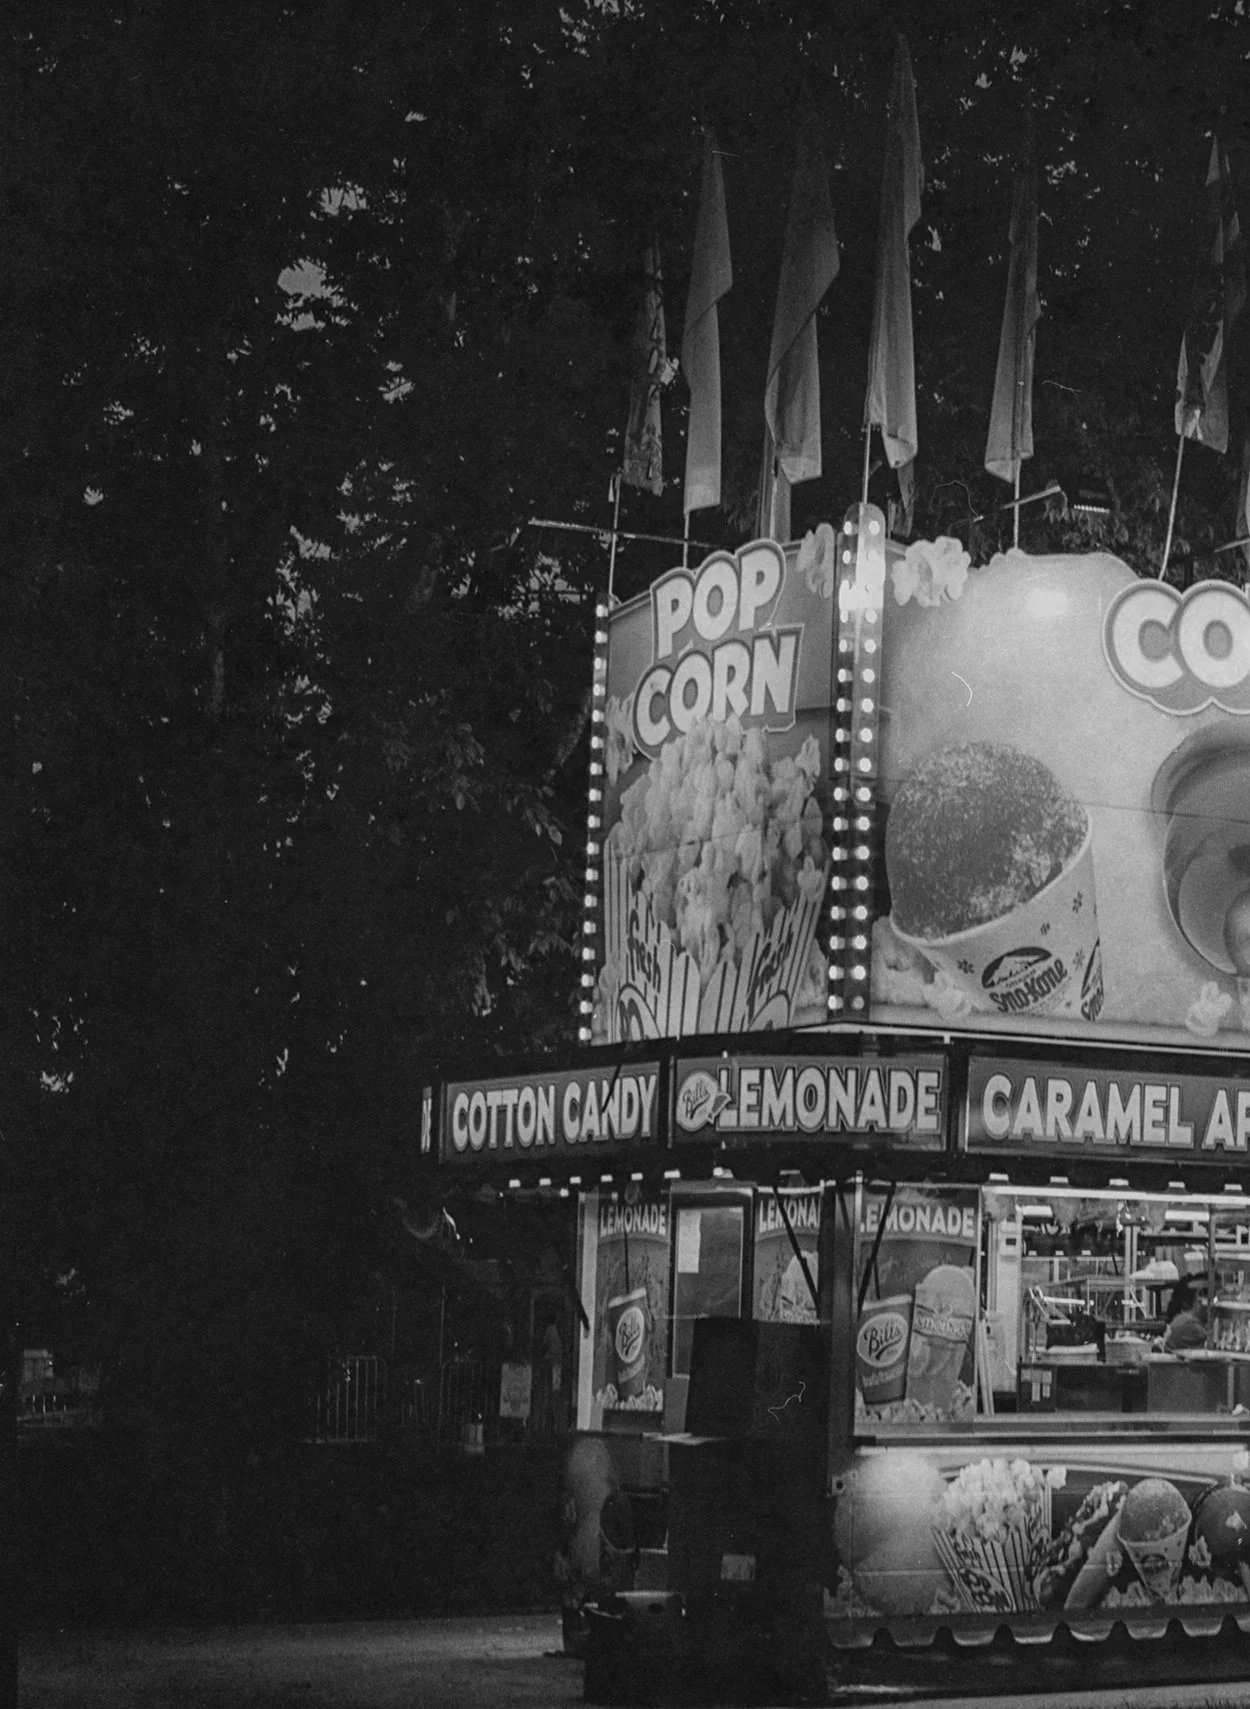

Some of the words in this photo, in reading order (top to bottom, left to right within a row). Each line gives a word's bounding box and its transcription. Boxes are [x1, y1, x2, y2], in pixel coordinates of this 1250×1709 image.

[655, 546, 781, 659] POP
[633, 635, 797, 747] CORN
[452, 1085, 556, 1153] COTTON
[563, 1074, 657, 1144] CANDY
[716, 1067, 942, 1133] LEMONADE
[982, 1074, 1195, 1150] CARAMEL
[600, 1204, 666, 1236] LEMONADE
